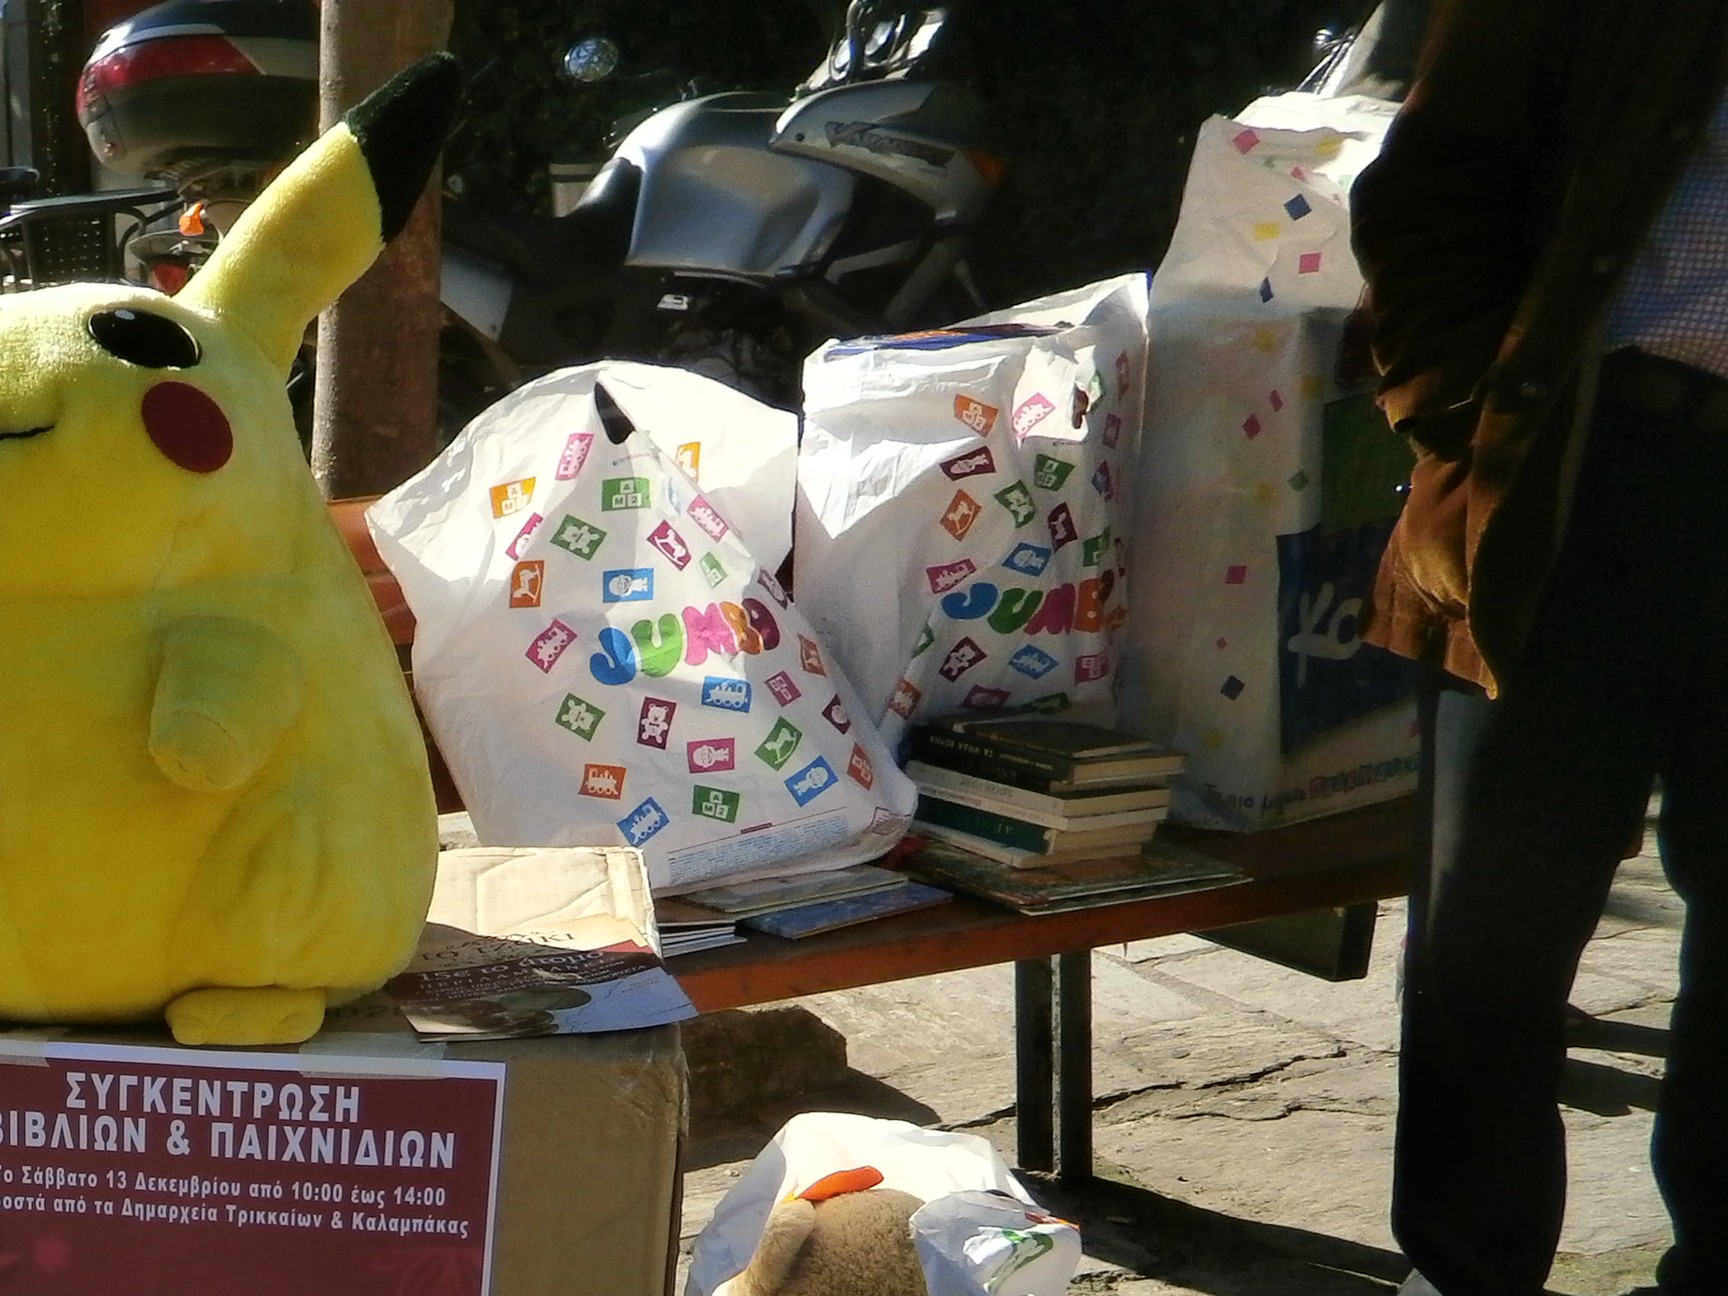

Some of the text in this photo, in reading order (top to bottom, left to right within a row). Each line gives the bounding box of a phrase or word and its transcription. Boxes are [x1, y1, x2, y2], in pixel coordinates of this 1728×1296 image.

[65, 1071, 360, 1124] ΣΥΓΚΕΝΤΡΩΣΗ
[166, 1119, 190, 1155] &
[210, 1122, 454, 1168] ΠΑΙΧΝΙΔΙΩΝ
[21, 1165, 97, 1189] Σάββατο
[106, 1169, 126, 1189] 13
[134, 1171, 240, 1198] Δεκεμβρίου
[248, 1180, 282, 1198] από
[291, 1181, 342, 1202] 10:00
[350, 1184, 385, 1208] έως
[393, 1185, 445, 1206] 14:00
[53, 1195, 86, 1213] από
[93, 1200, 113, 1214] τα
[121, 1197, 217, 1224] Δημαρχεία
[225, 1204, 322, 1227] Τρικκαίων
[330, 1210, 342, 1229] &
[351, 1211, 468, 1238] Καλαμπάκας
